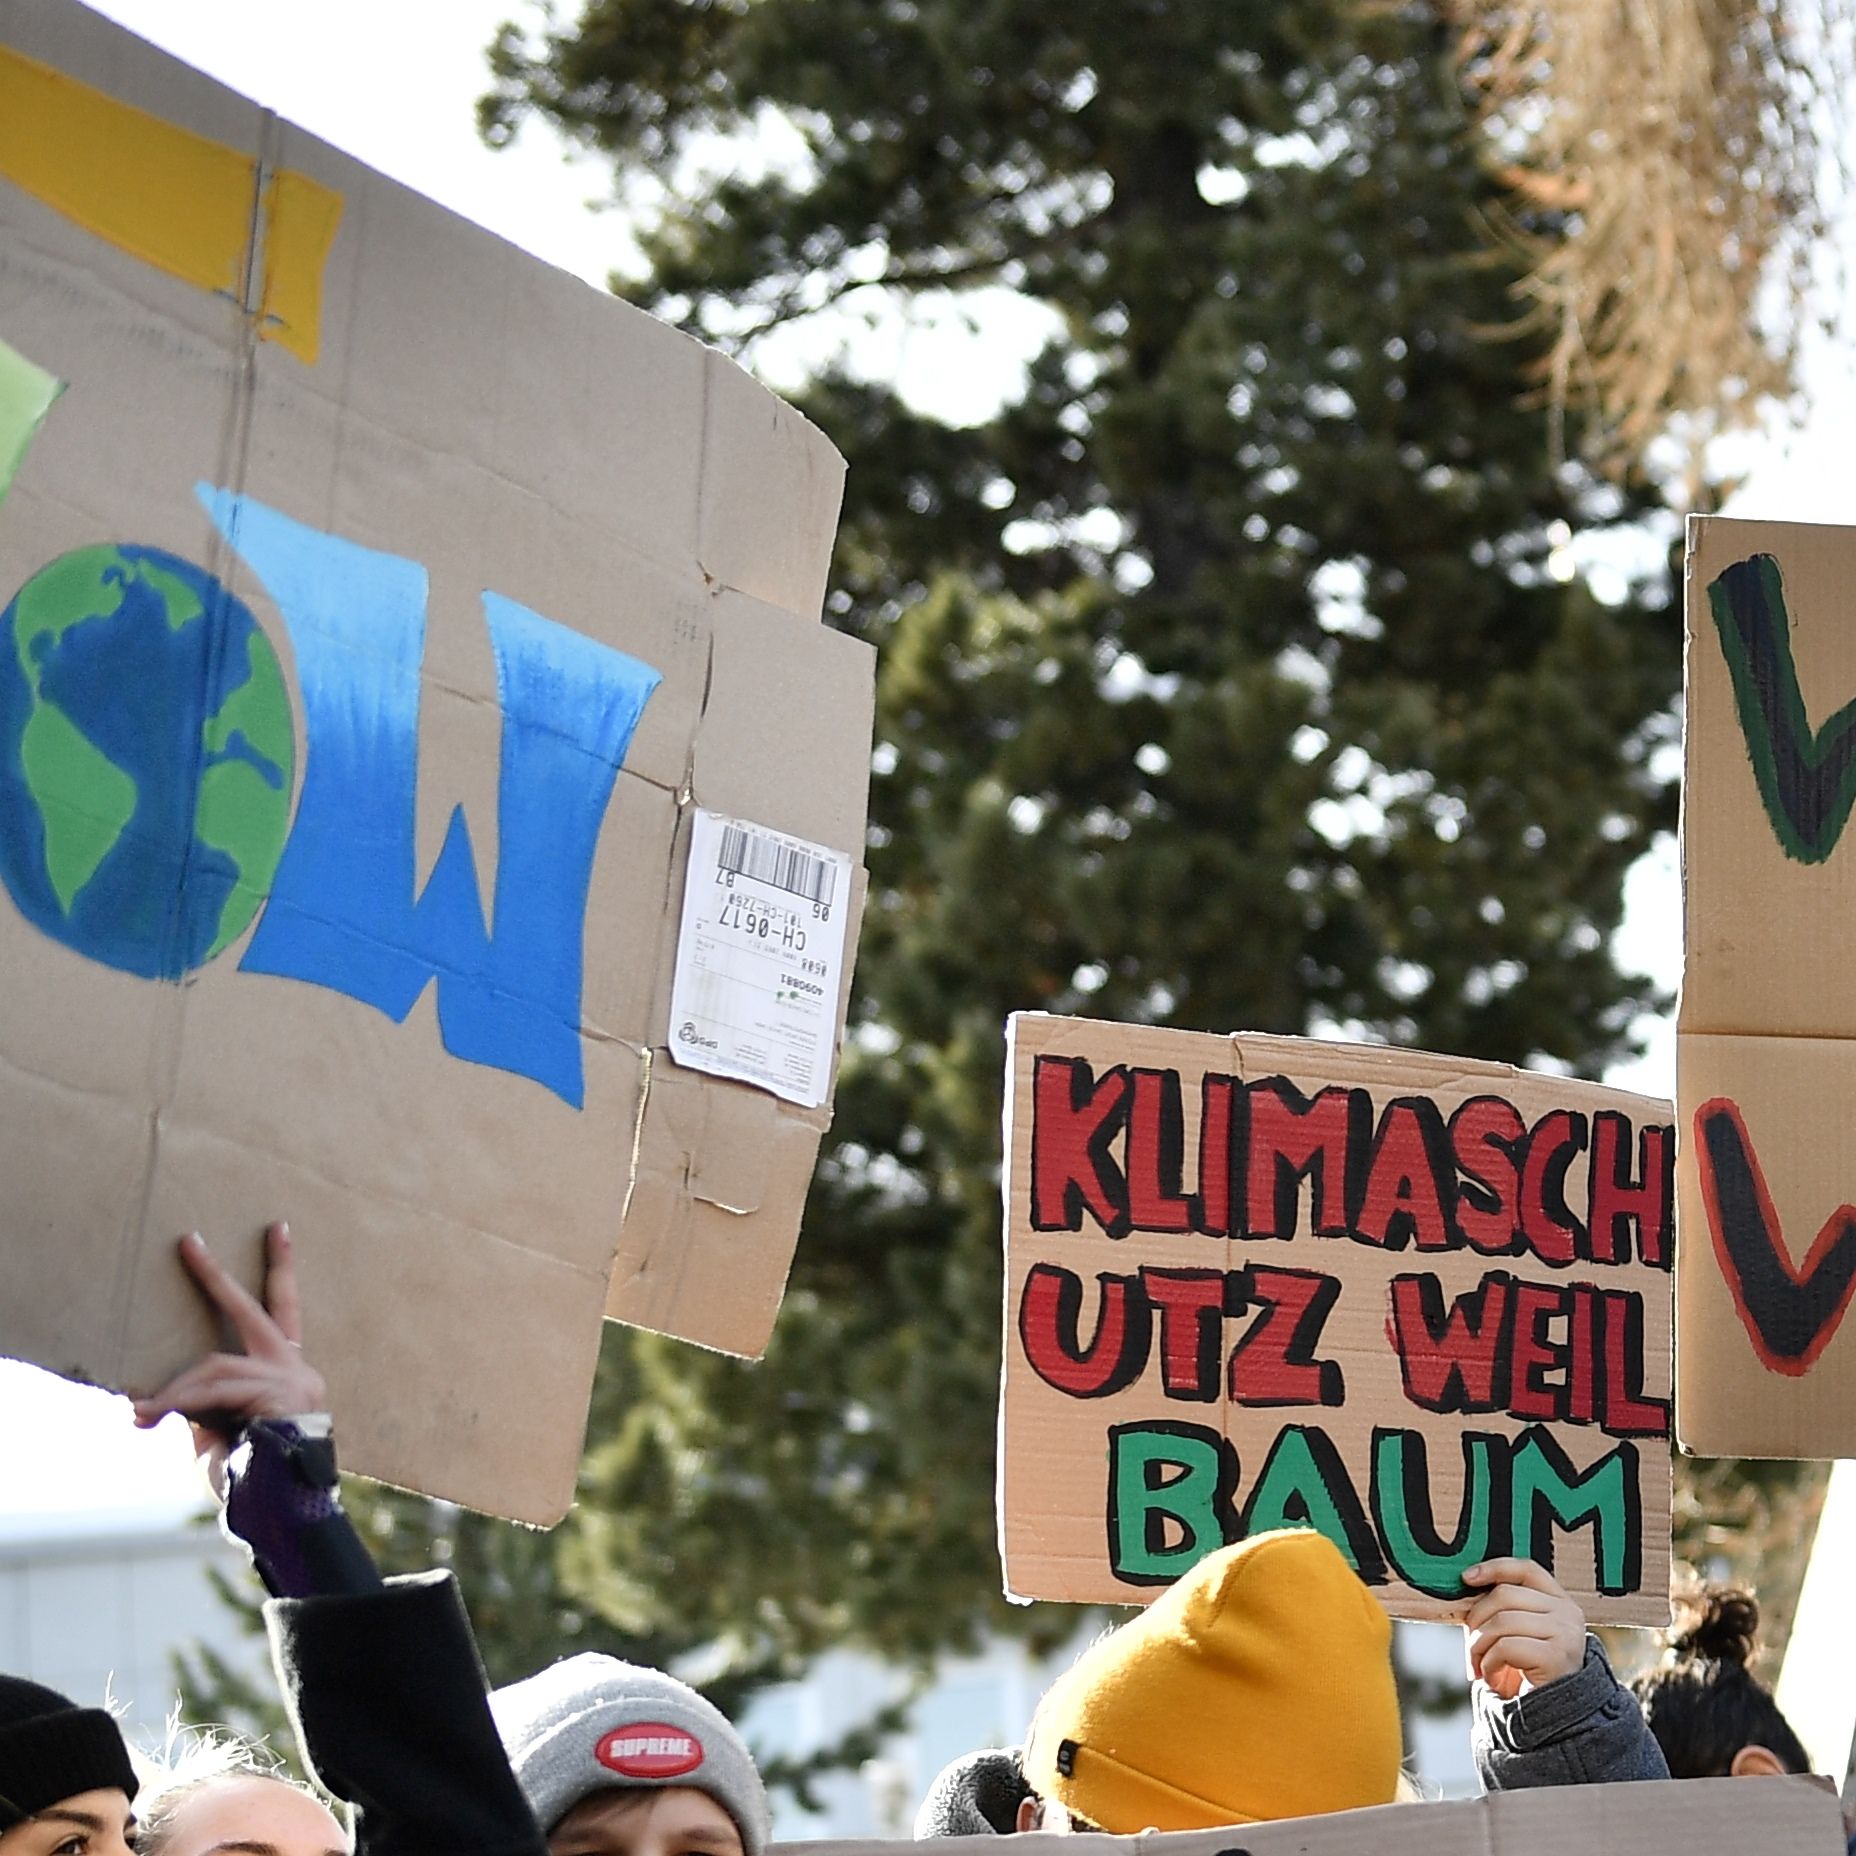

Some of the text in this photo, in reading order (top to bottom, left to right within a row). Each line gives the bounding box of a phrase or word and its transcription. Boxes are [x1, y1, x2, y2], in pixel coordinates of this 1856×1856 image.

[718, 907, 808, 952] CH-0617
[1031, 1055, 1675, 1272] KLIMASCH
[1018, 1261, 1670, 1441] UTZ WEIL
[1106, 1420, 1642, 1599] BAUM
